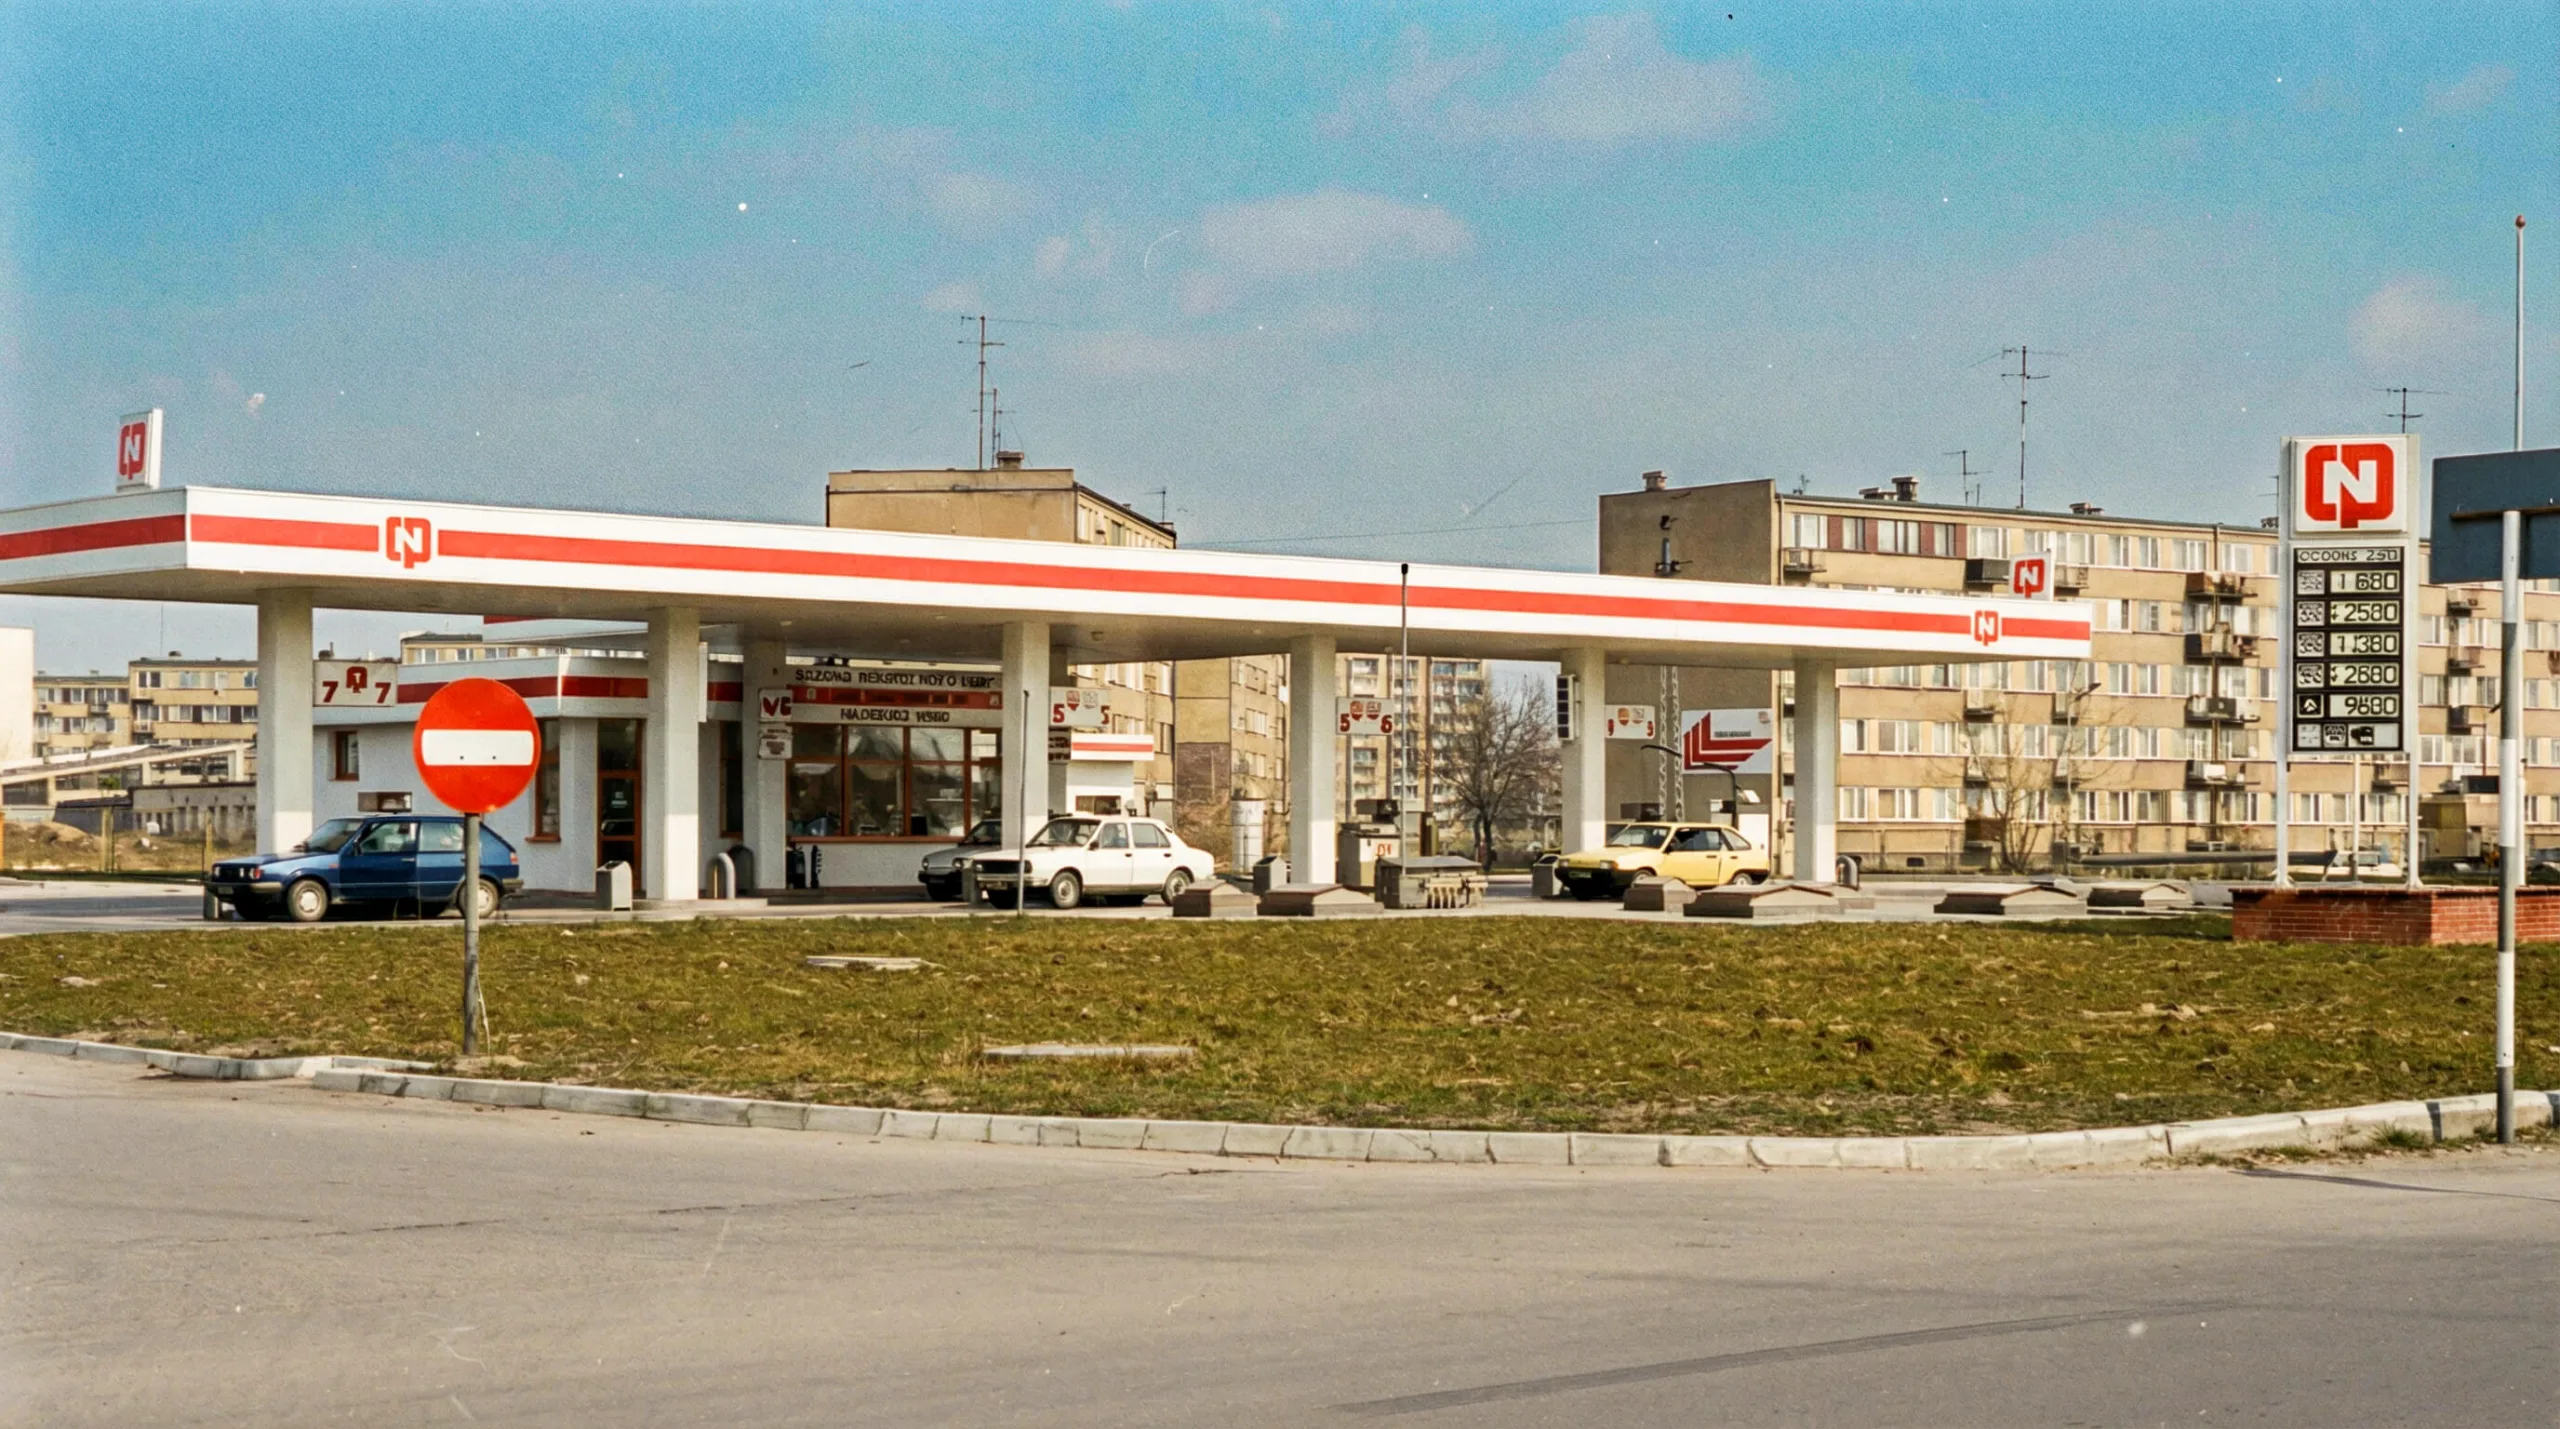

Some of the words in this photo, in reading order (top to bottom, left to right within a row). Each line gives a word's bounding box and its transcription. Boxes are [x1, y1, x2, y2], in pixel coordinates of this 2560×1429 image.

[322, 681, 339, 703] 7
[375, 682, 392, 704] 7
[1052, 703, 1065, 723] 5
[1380, 714, 1393, 734] 6
